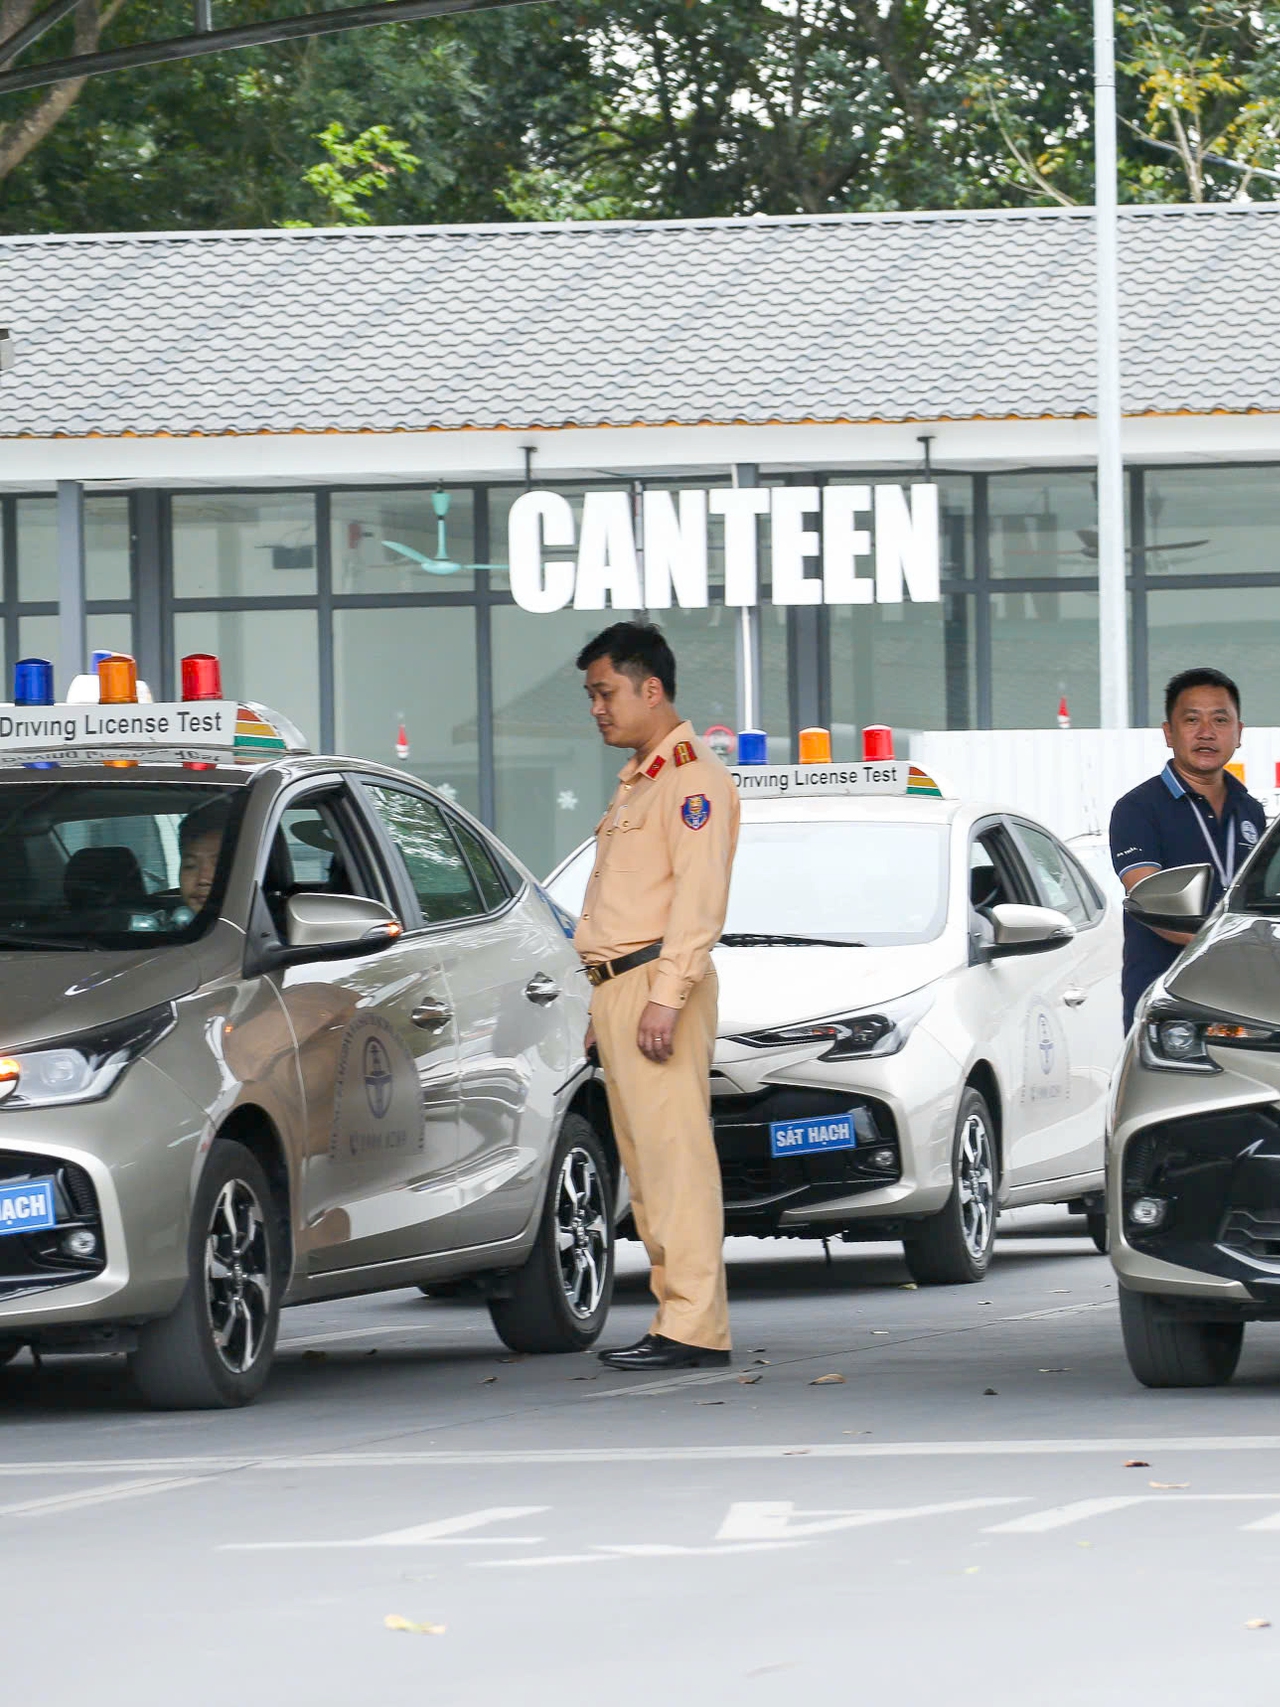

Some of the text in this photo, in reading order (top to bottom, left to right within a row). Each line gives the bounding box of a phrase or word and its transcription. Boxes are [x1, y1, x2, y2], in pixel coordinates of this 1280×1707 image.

[508, 483, 942, 613] CANTEEN
[0, 711, 223, 742] Driving License Test
[795, 770, 858, 786] License
[863, 766, 898, 783] Test
[775, 1122, 850, 1148] SÁT HẠCH
[0, 1193, 47, 1226] ẠCH
